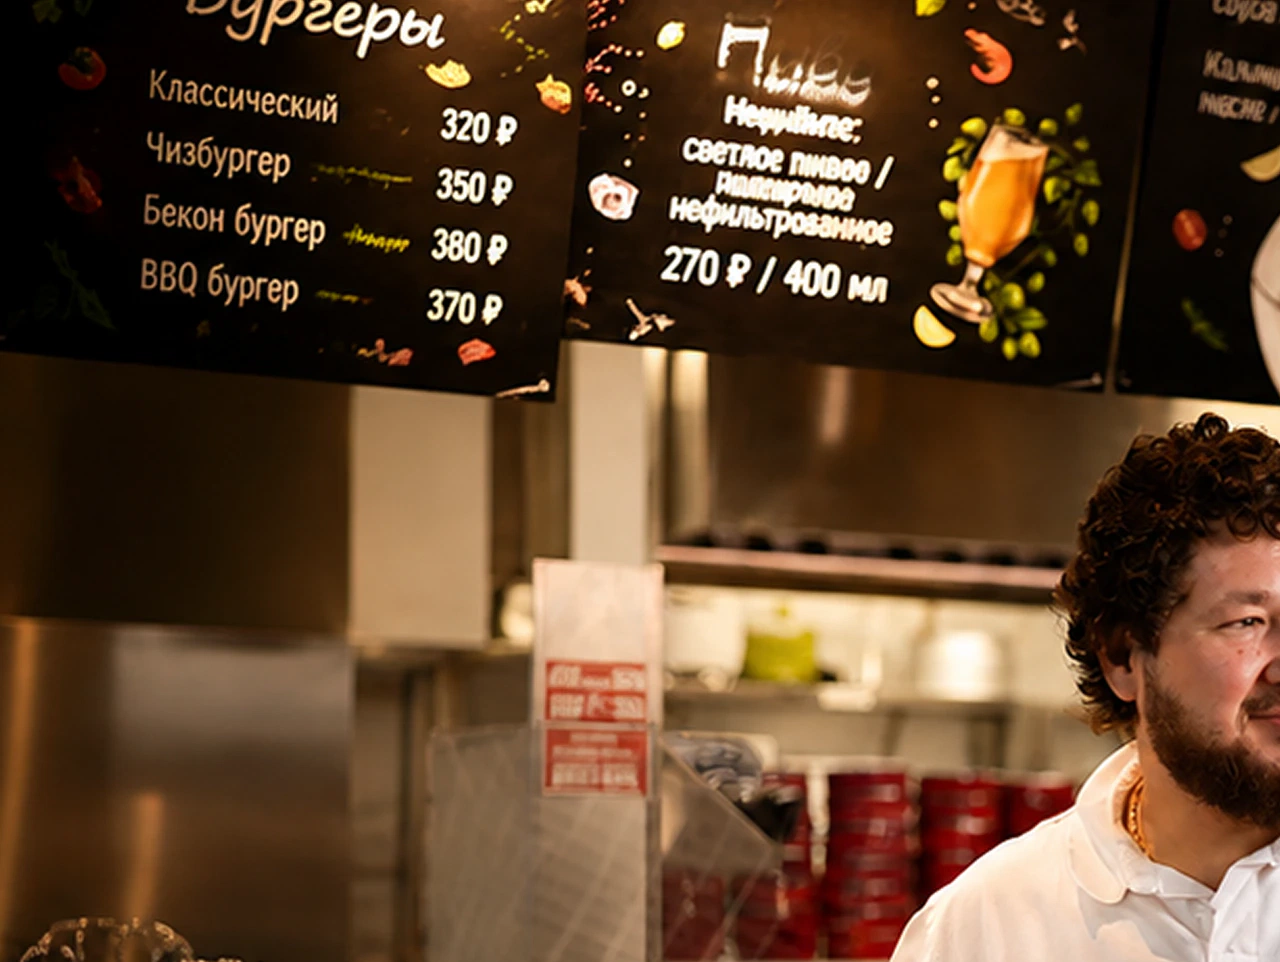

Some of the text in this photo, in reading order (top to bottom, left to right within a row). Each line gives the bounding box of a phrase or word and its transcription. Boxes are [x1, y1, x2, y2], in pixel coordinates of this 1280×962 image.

[150, 69, 338, 124] Классический
[440, 107, 518, 146] 320 ₽
[147, 131, 291, 184] Чизбургер
[436, 167, 486, 204] 350
[491, 173, 513, 206] ₽
[144, 194, 225, 233] Бекон
[235, 203, 326, 251] бургер
[669, 193, 894, 246] нефильтрованное
[431, 227, 481, 263] 380
[487, 234, 508, 266] ₽
[141, 258, 299, 312] BBQ бургер
[660, 245, 720, 286] 270
[783, 259, 841, 299] 400
[847, 274, 889, 303] мл
[426, 288, 503, 325] 370 ₽
